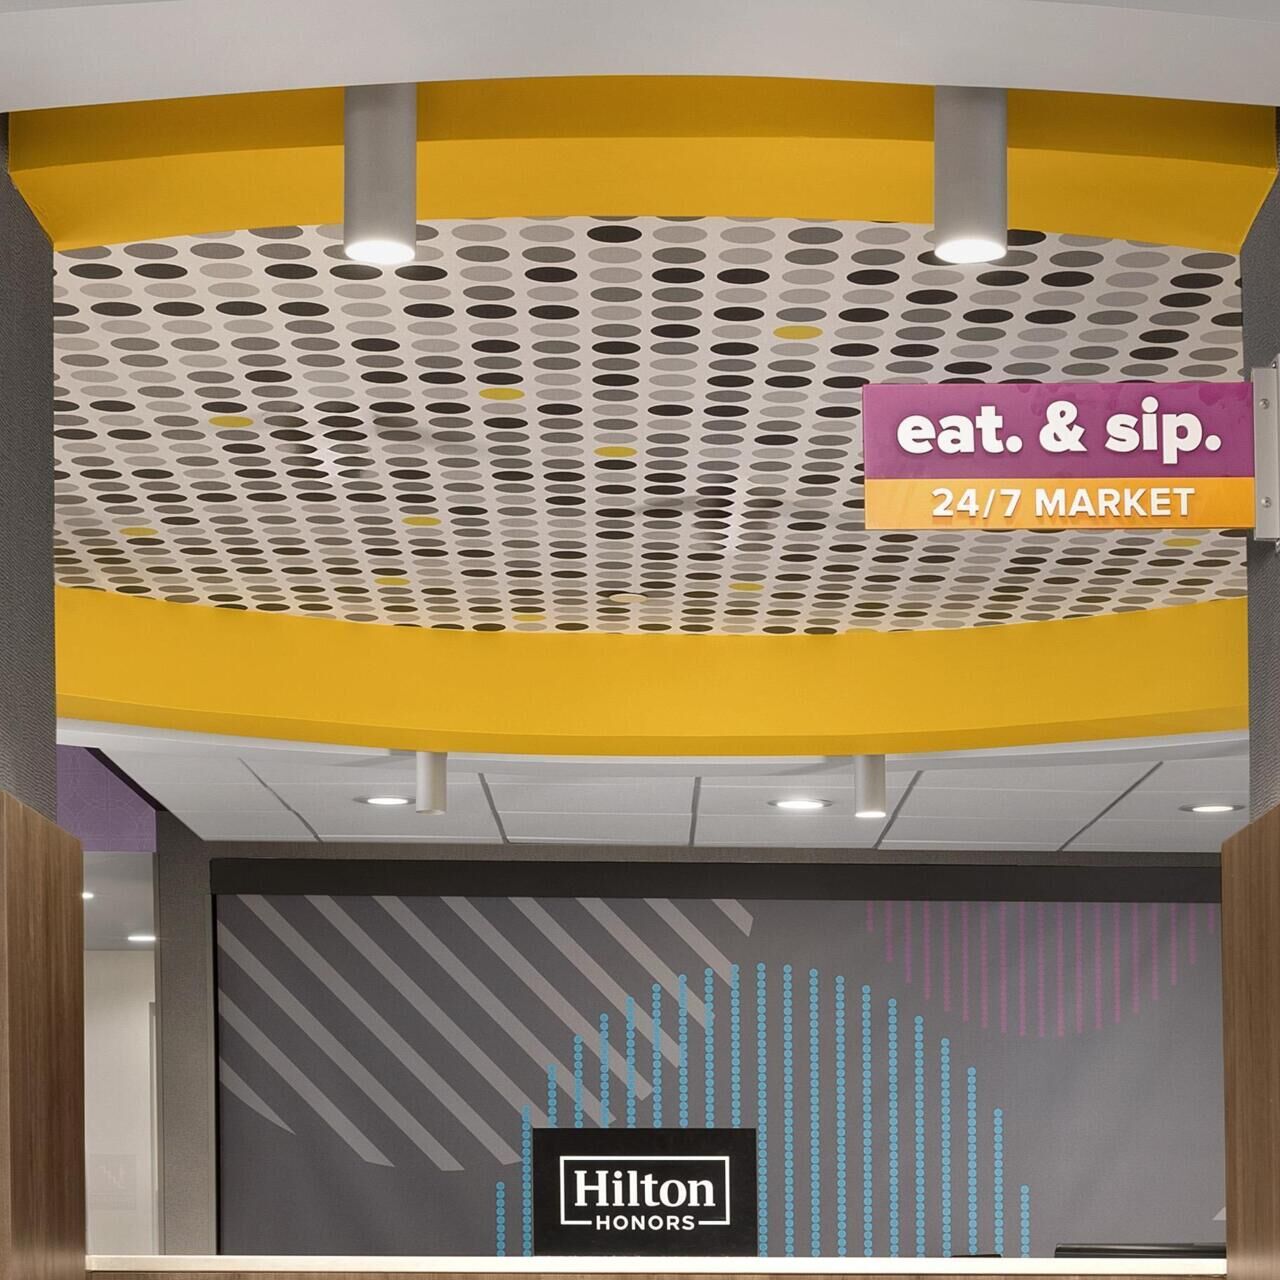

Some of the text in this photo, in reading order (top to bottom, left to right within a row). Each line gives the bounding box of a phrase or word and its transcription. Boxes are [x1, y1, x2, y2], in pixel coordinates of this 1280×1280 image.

[897, 396, 1221, 464] eat. & sip.
[931, 487, 1195, 518] 24/7 MARKET
[574, 1169, 717, 1208] Hilton
[596, 1215, 695, 1230] HONORS
